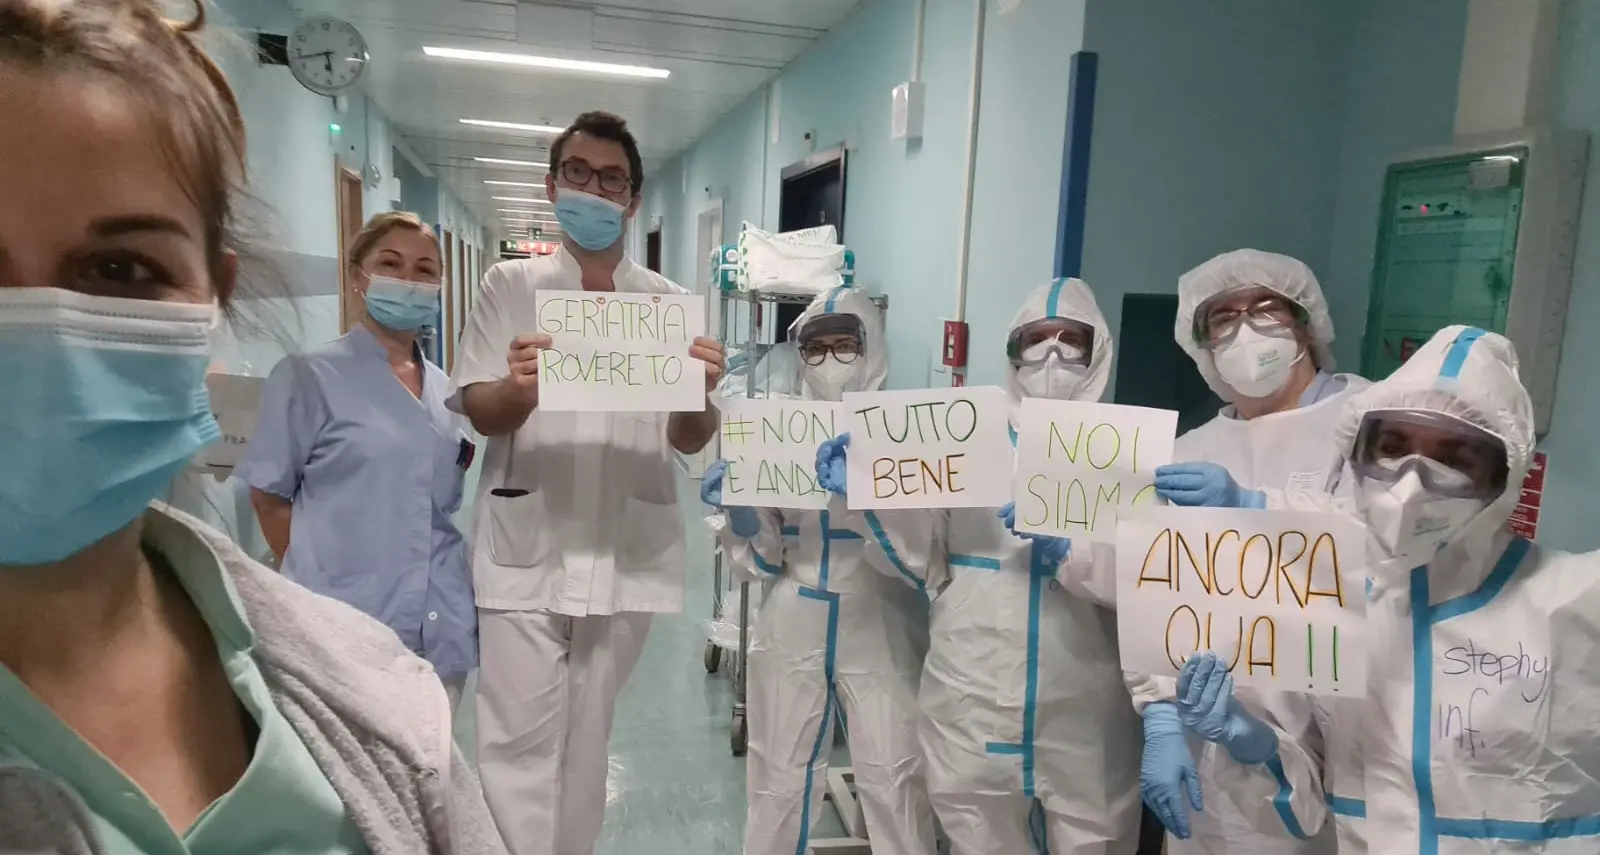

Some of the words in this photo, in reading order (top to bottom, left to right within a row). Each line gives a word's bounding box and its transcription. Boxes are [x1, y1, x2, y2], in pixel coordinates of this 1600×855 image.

[538, 296, 687, 342] GERIATRIA
[854, 399, 977, 443] TUTTO
[1047, 420, 1140, 474] NOI
[872, 453, 966, 499] BENE
[1136, 528, 1344, 609] ANCORA
